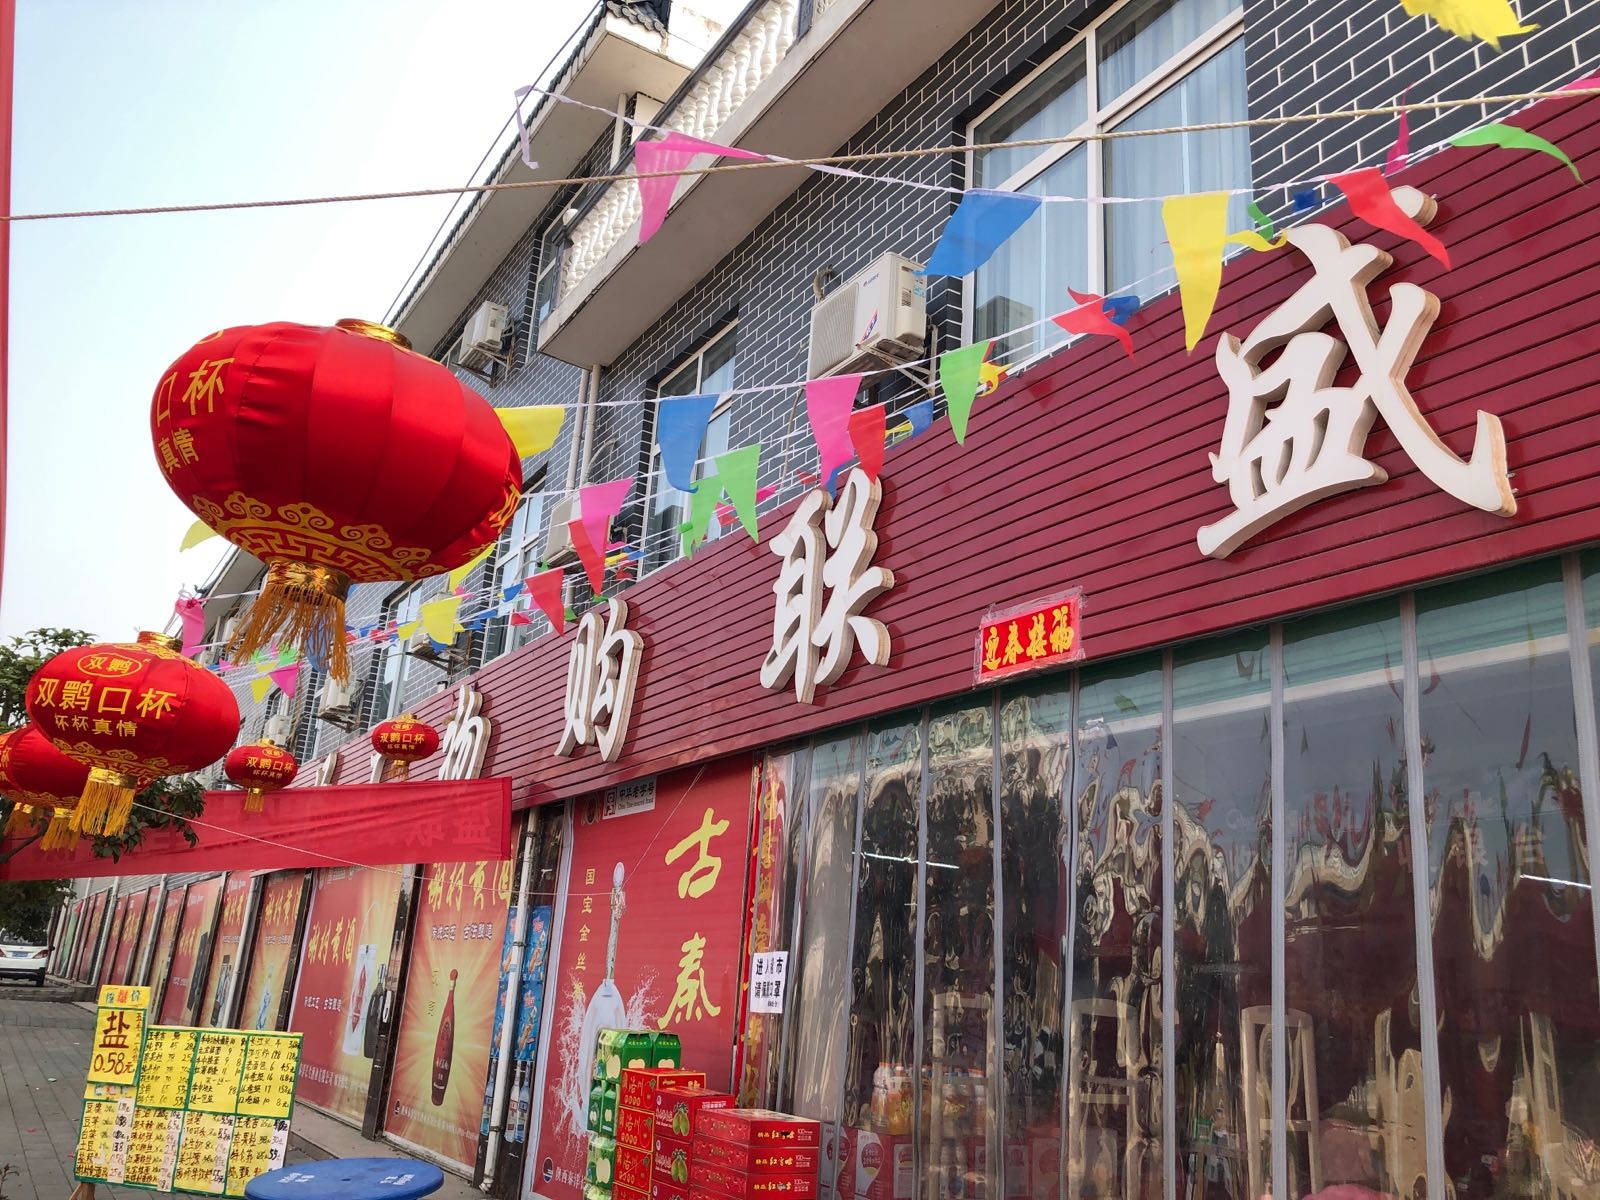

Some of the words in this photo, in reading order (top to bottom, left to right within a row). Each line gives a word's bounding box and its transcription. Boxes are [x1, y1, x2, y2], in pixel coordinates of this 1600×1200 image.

[98, 1010, 131, 1049] 盐
[93, 1052, 135, 1075] 0.58元
[234, 1117, 260, 1129] 王老吉
